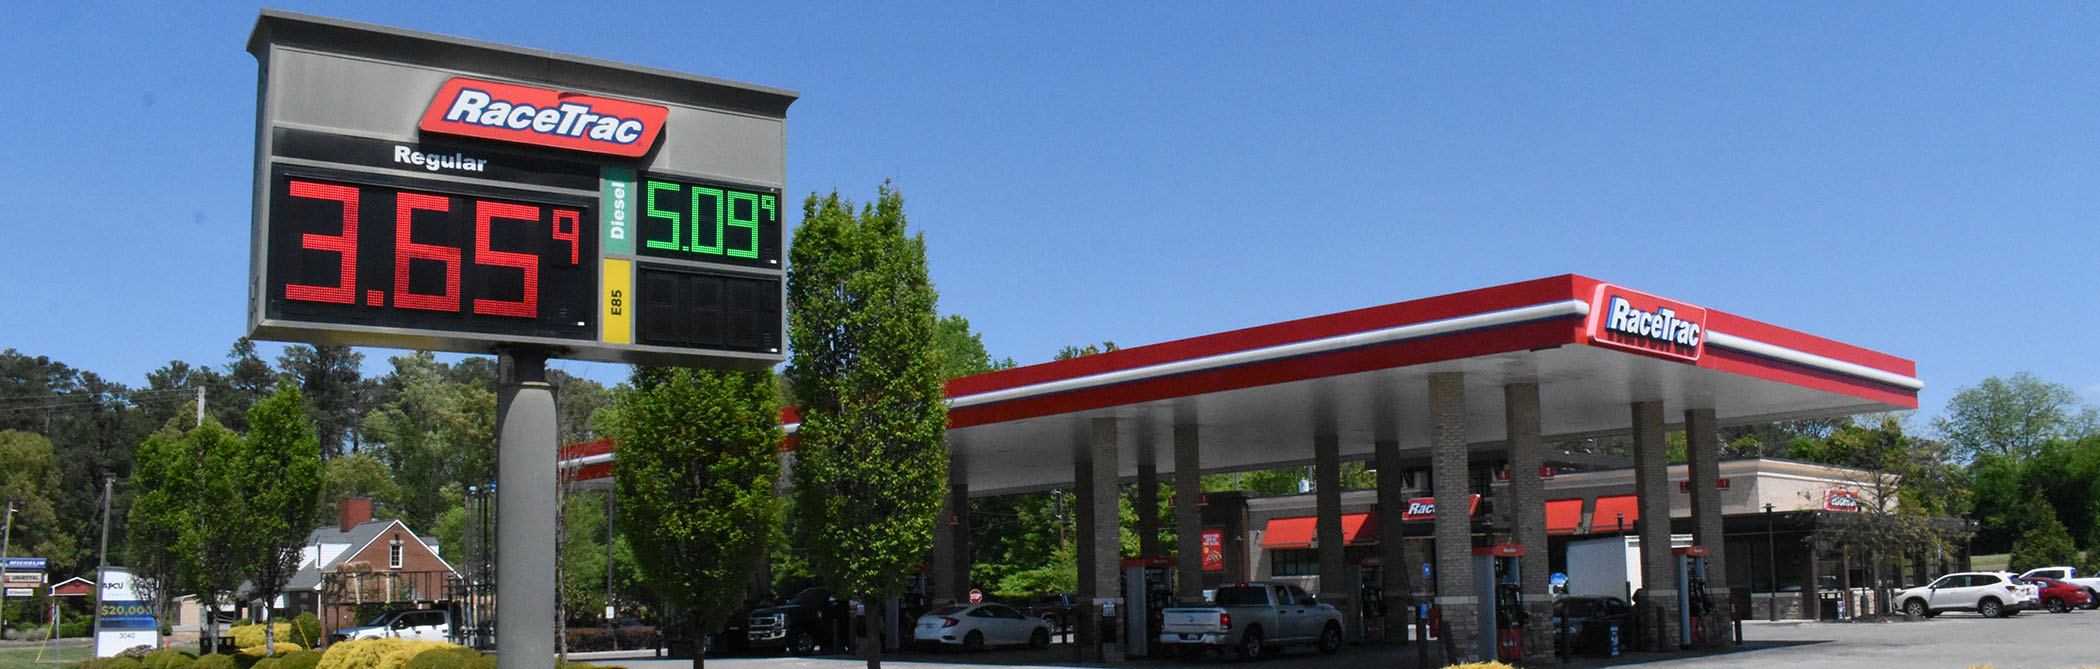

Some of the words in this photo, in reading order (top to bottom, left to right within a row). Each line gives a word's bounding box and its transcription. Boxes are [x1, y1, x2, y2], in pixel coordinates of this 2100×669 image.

[444, 87, 644, 145] RaceTrac
[394, 145, 488, 172] Regular
[611, 182, 625, 240] Diesel
[611, 289, 623, 316] E85
[1605, 295, 1701, 349] RaceTrac
